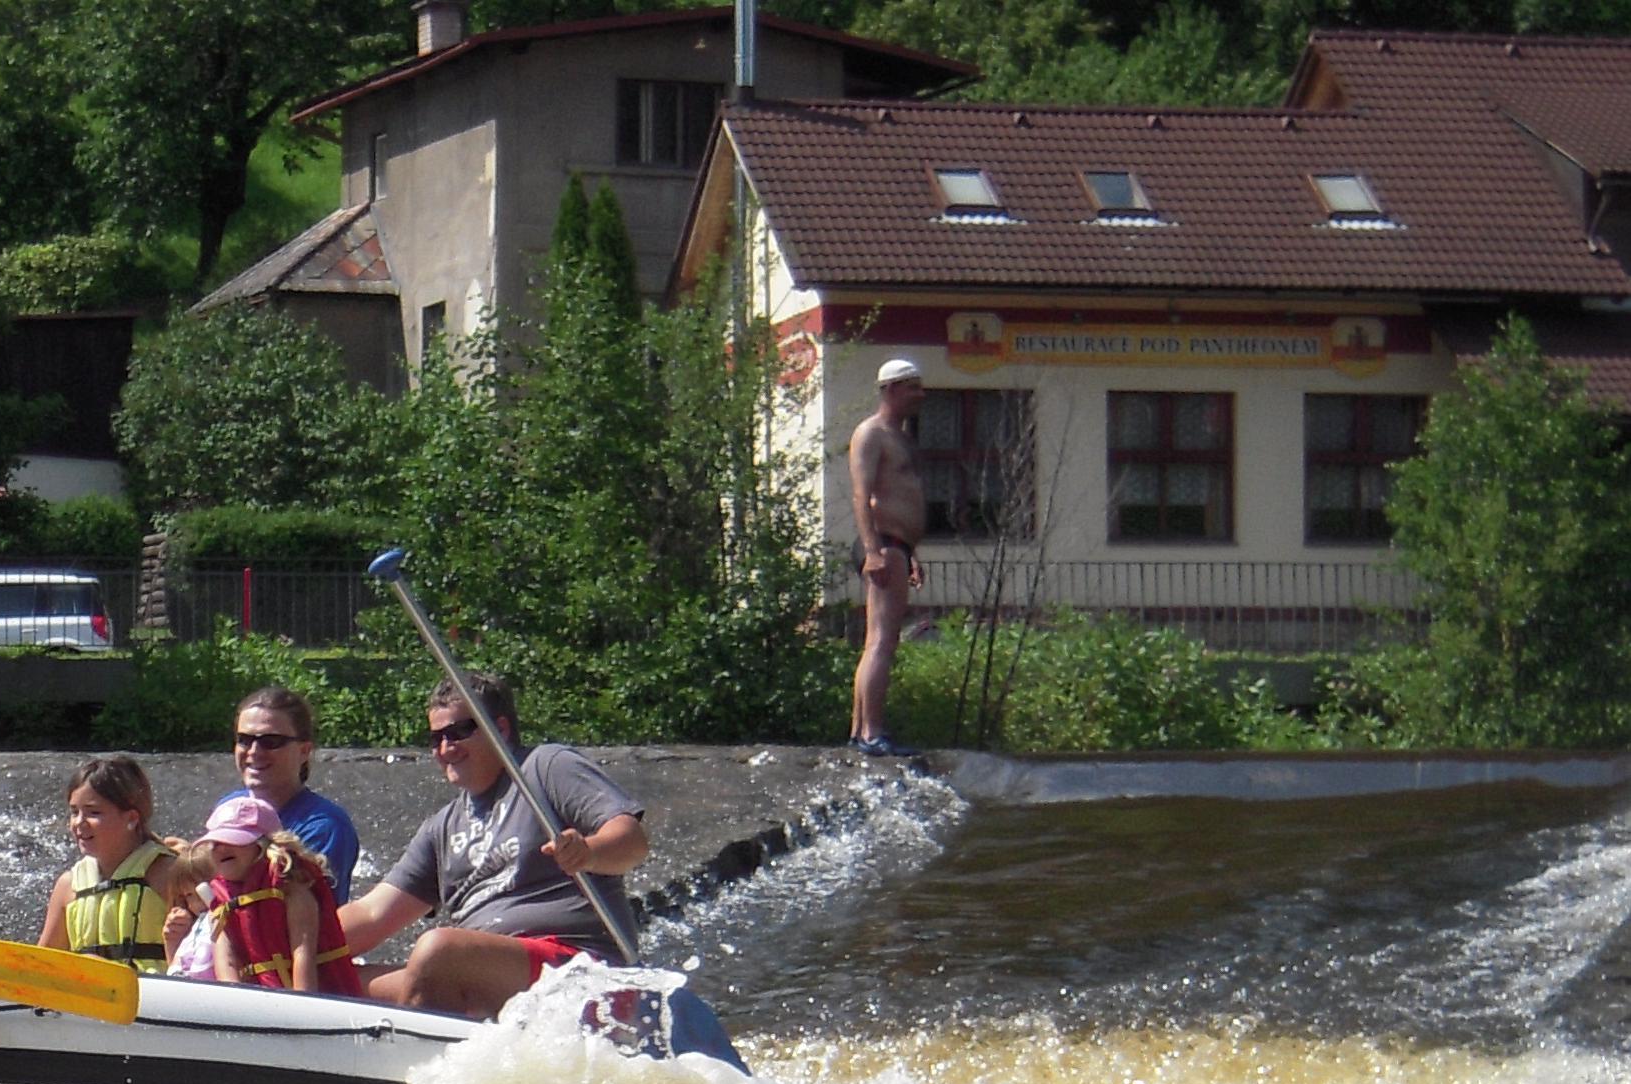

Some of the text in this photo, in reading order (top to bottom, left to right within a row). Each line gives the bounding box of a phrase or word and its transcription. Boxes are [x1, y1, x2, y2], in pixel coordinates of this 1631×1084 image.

[1015, 336, 1319, 355] RESTAURACE POD PANTHEONEM
